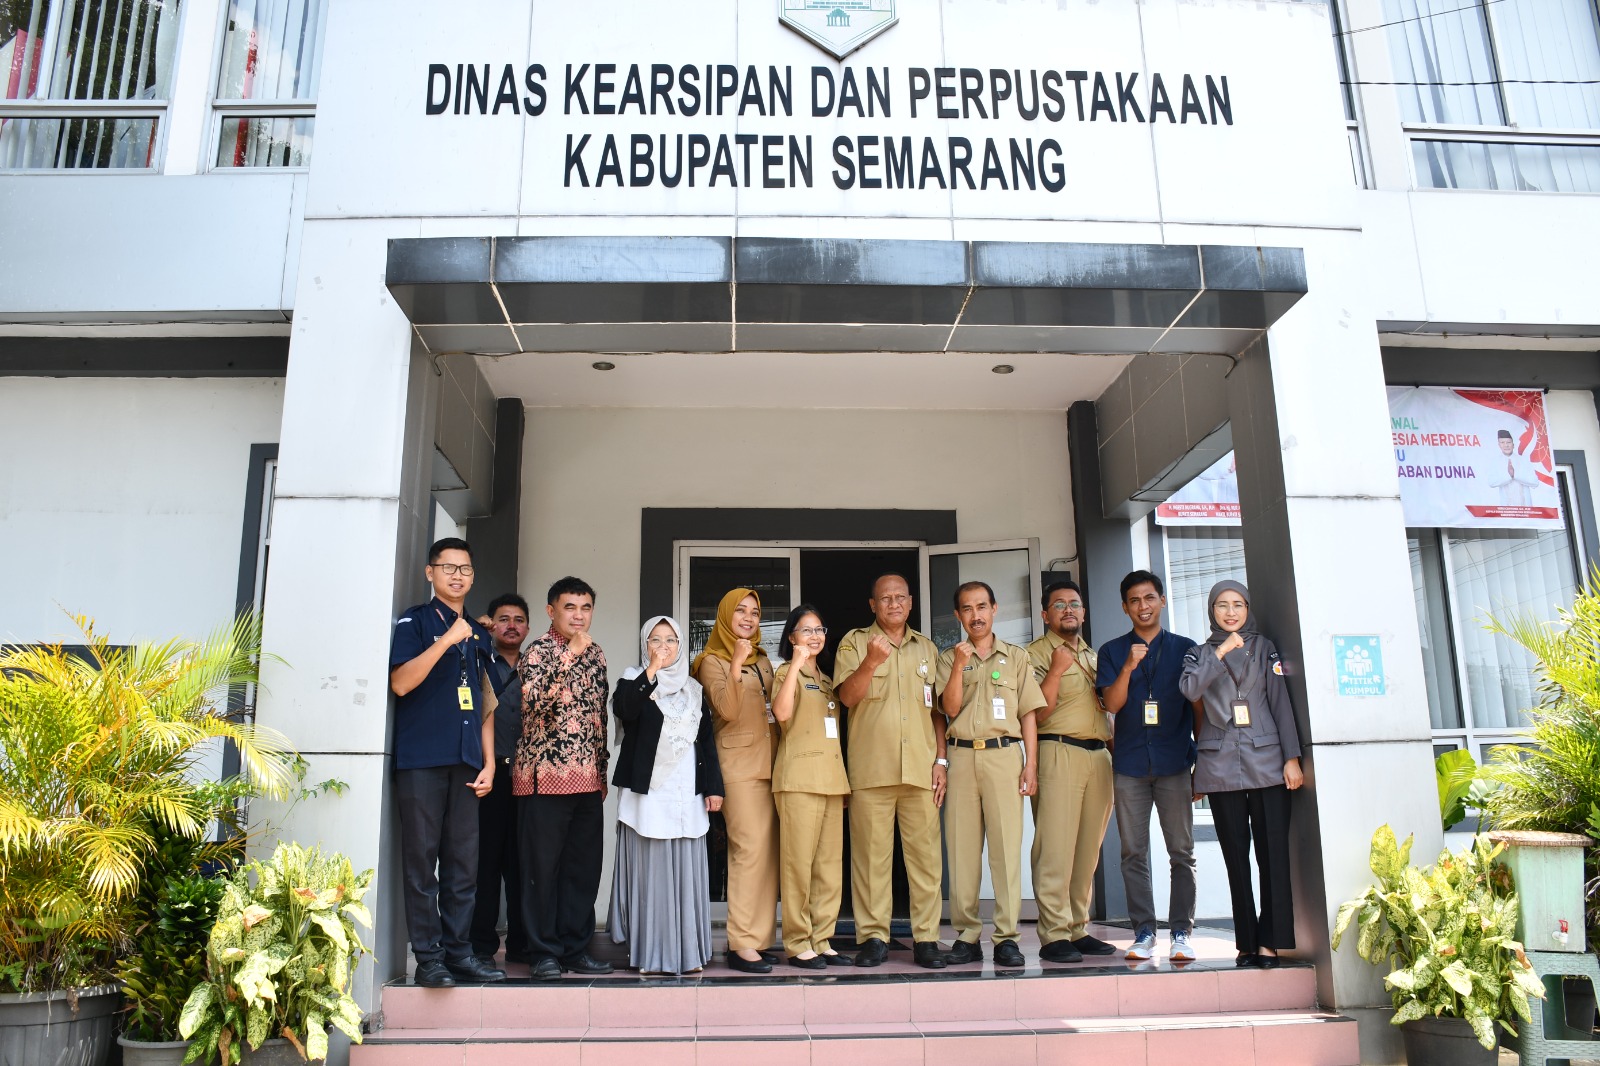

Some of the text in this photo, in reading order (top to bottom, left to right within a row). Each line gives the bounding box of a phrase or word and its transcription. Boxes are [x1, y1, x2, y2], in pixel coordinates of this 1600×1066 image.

[425, 63, 1234, 126] DINAS KEARSIPAN DAN PERPUSTAKAAN
[563, 133, 1066, 193] KABUPATEN SEMARANG
[1421, 433, 1481, 447] MERDEKA
[1398, 465, 1476, 479] ABAN DUNIA
[1348, 677, 1373, 685] TITIK
[1345, 687, 1382, 695] KUMPUL
